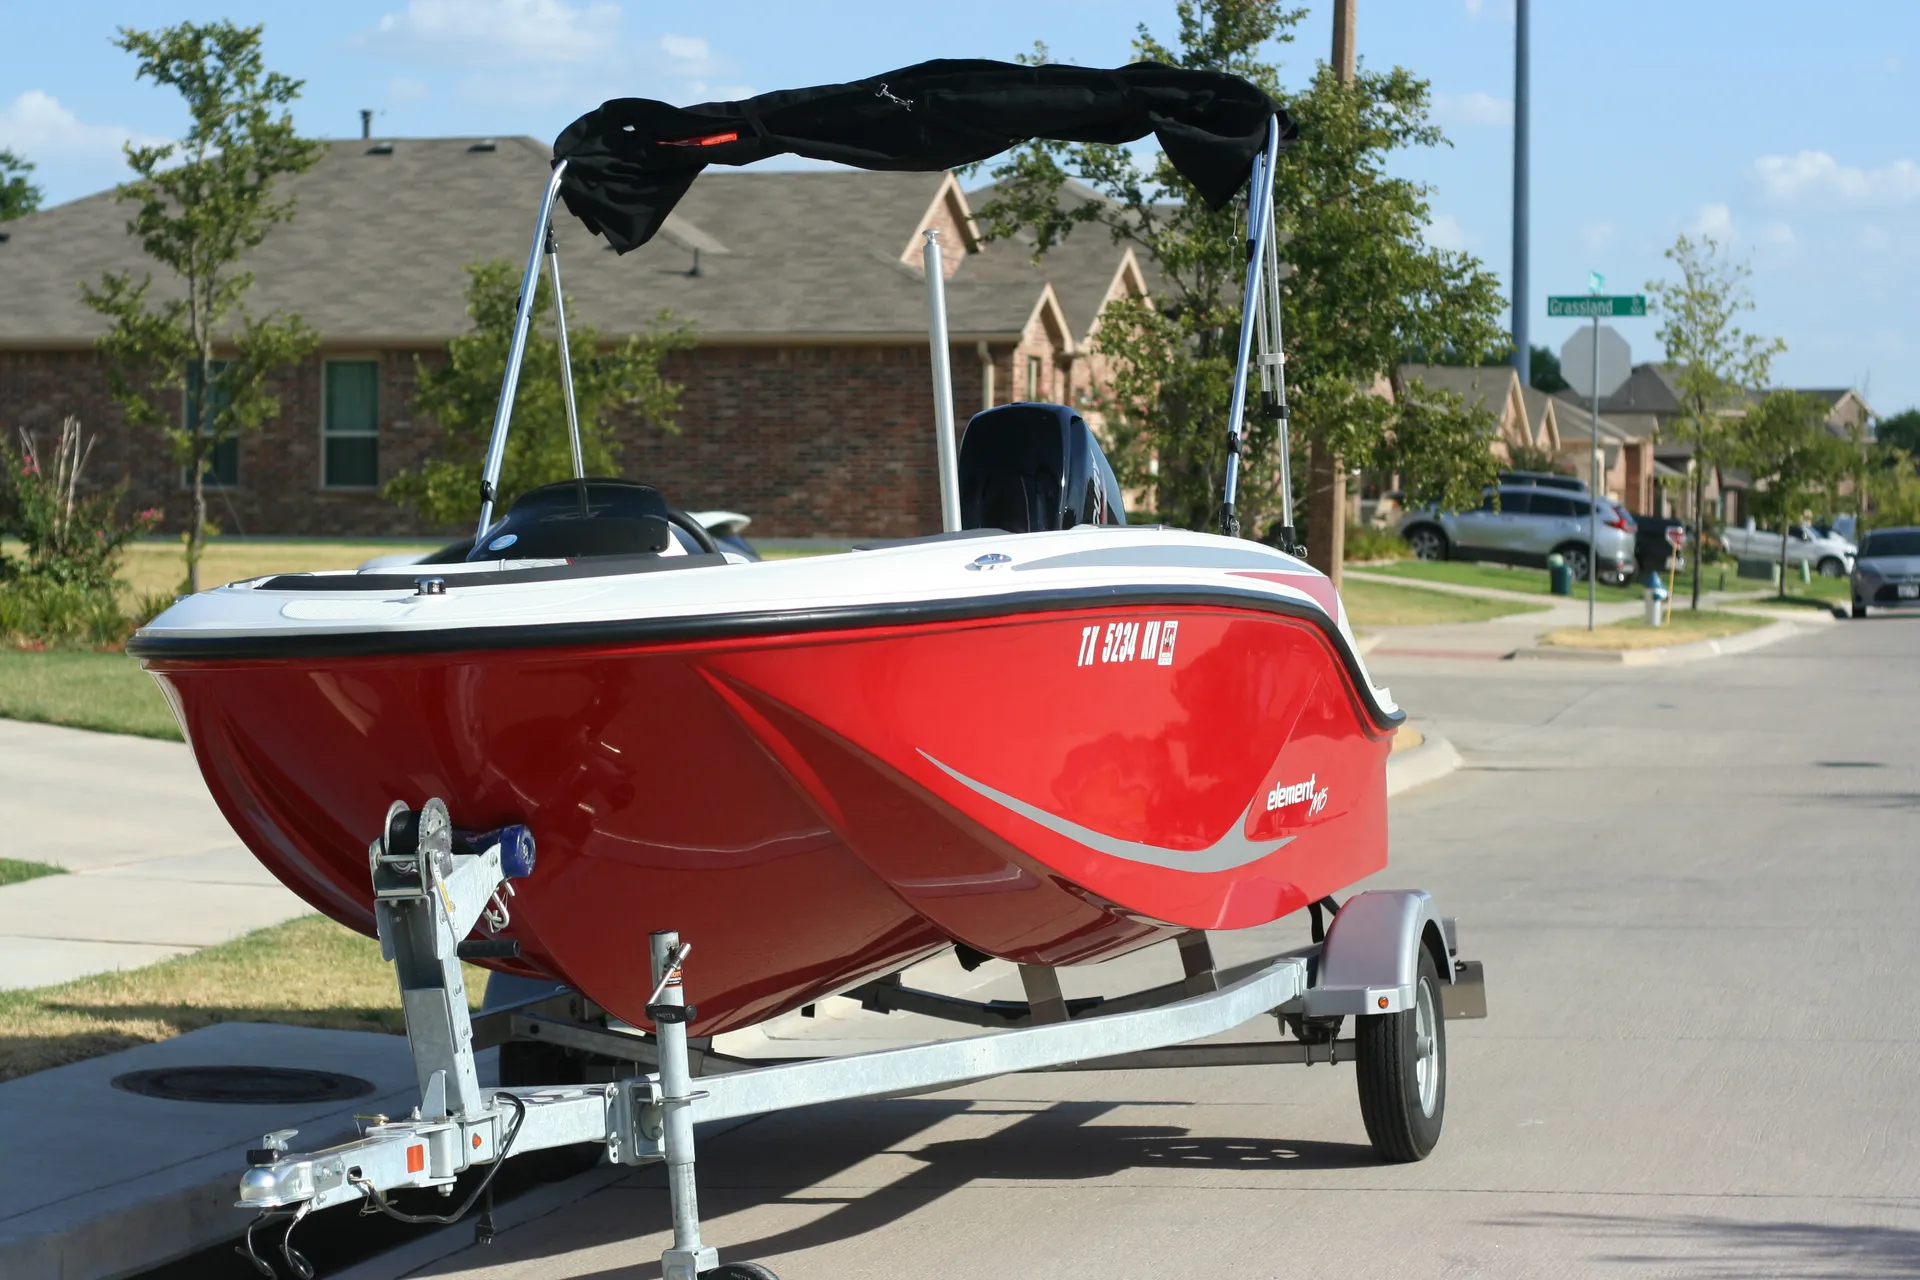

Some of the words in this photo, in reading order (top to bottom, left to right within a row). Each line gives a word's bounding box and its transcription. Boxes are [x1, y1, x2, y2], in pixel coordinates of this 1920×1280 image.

[1550, 299, 1613, 315] Grassland
[1077, 626, 1100, 666] TX
[1102, 621, 1140, 663] 5234
[1267, 773, 1315, 811] element
